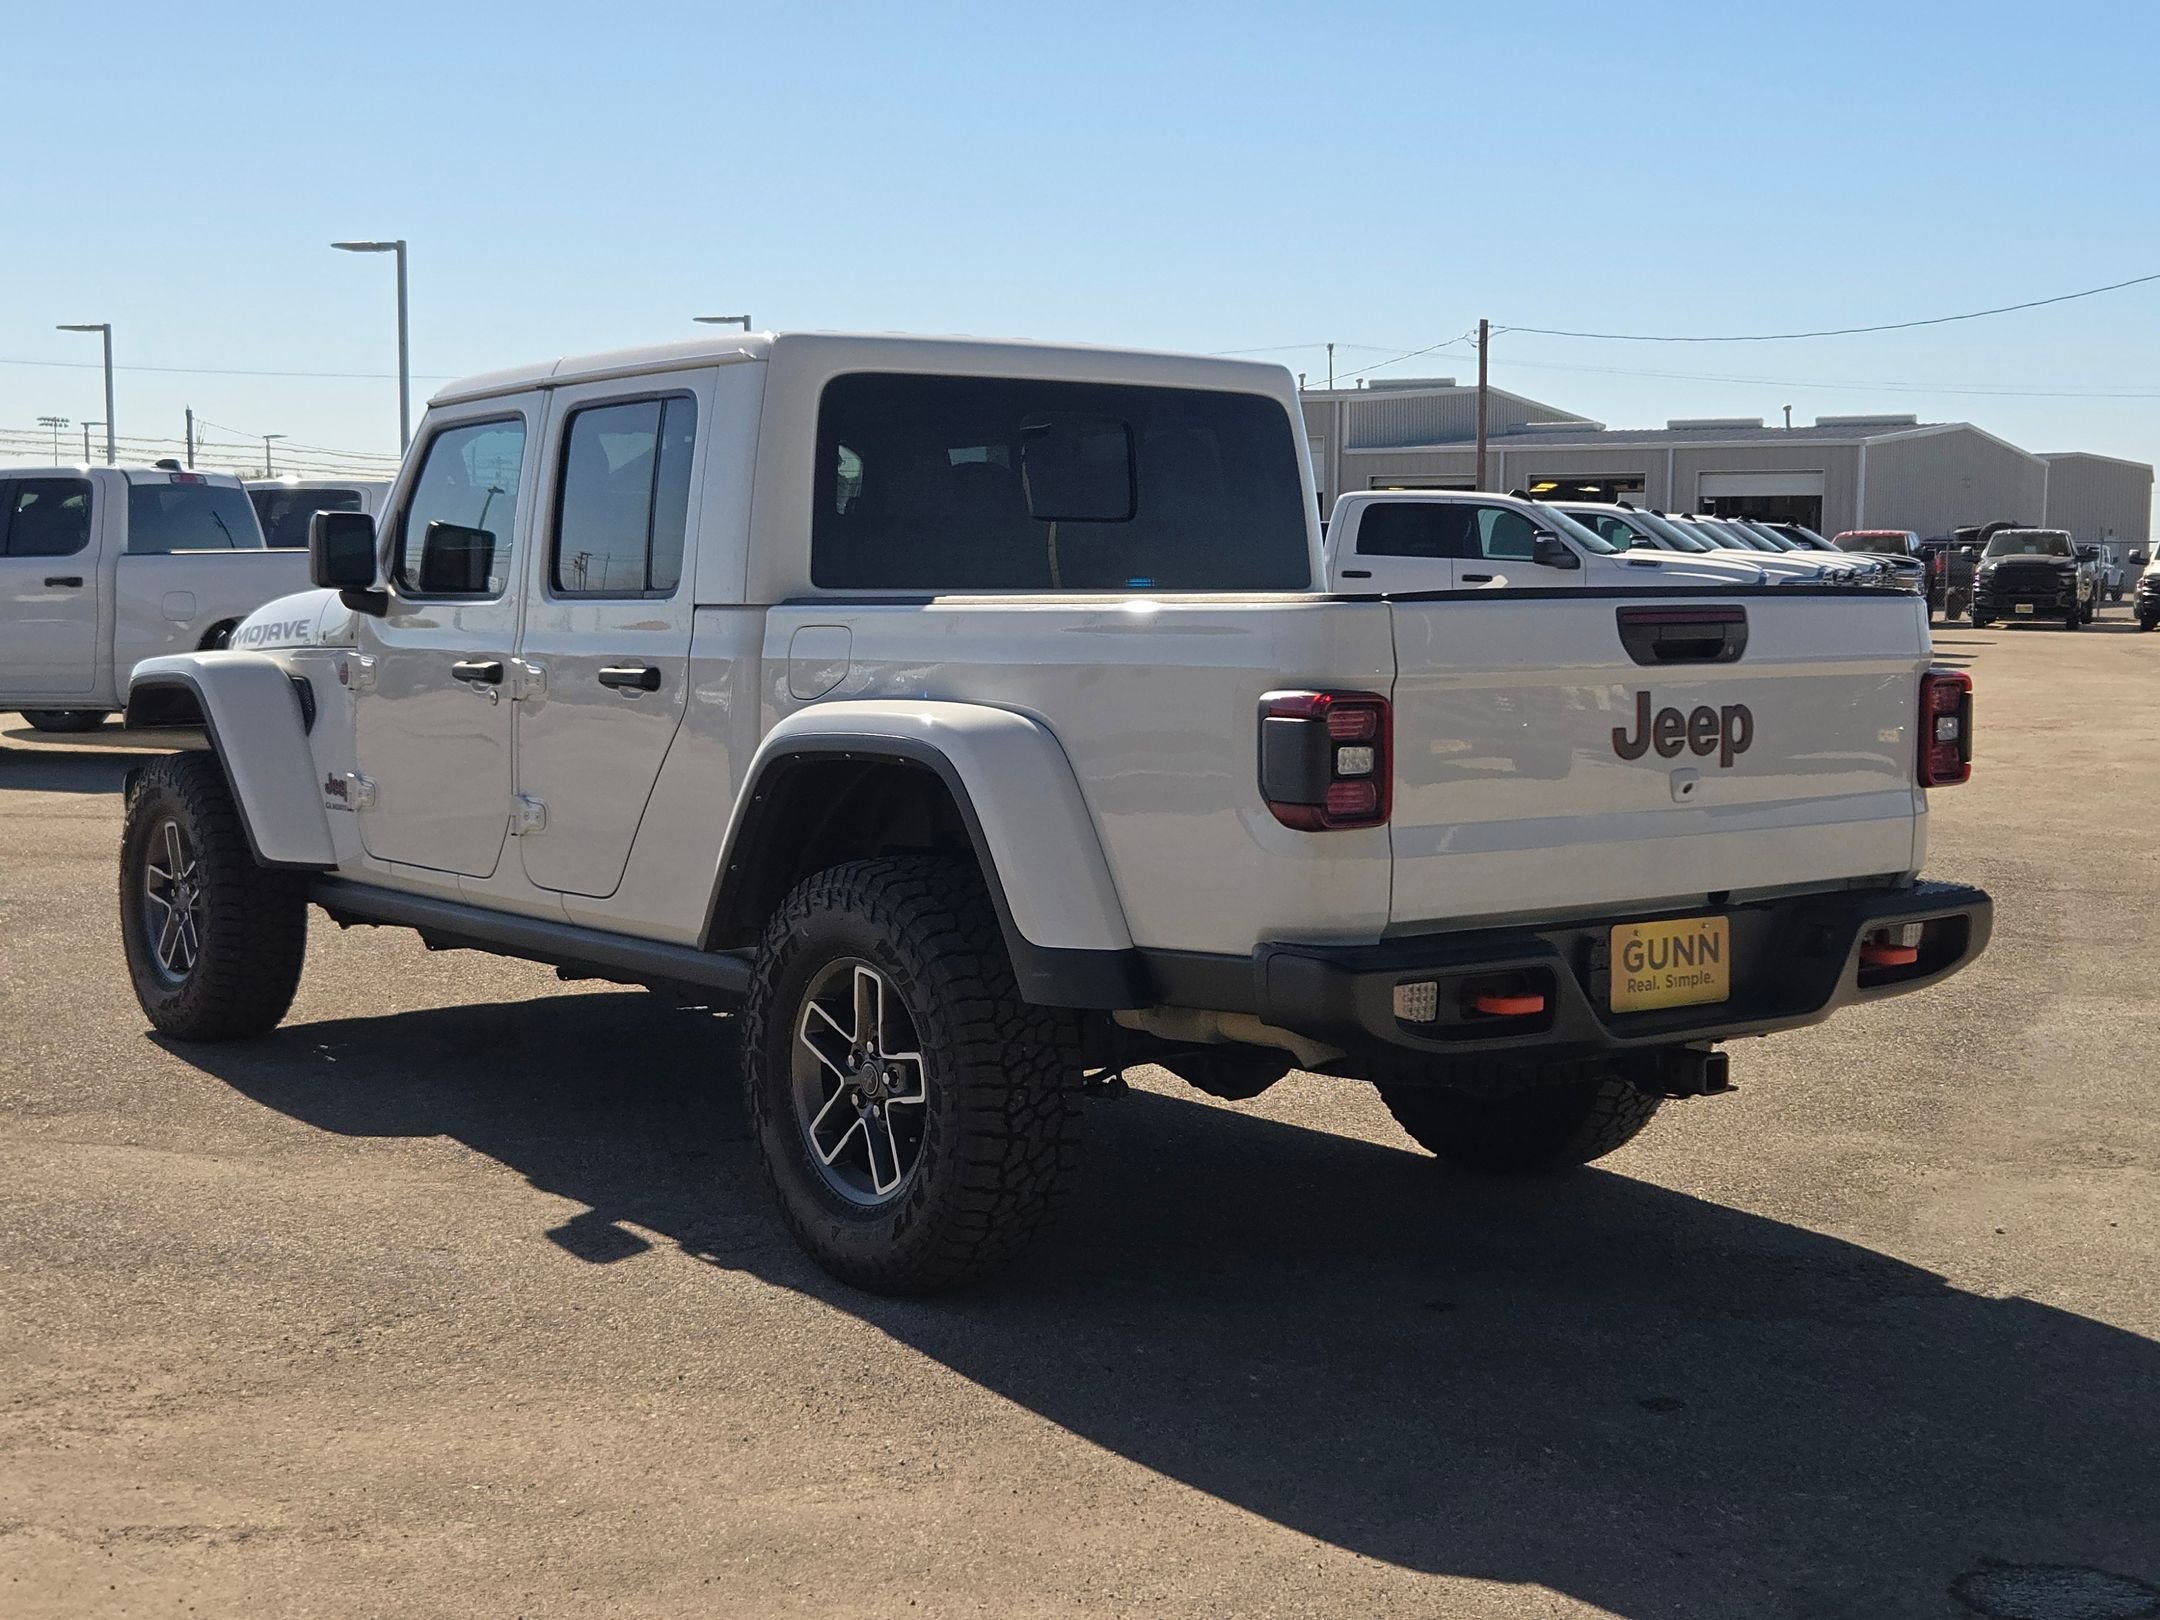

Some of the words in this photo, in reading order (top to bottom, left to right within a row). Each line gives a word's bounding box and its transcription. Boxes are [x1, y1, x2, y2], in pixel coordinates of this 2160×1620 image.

[232, 619, 311, 646] MOJAVE
[1611, 691, 1754, 769] Jeep
[1623, 932, 1720, 973] GUNN
[1627, 976, 1660, 993] Real.
[1665, 971, 1715, 989] Simple.
